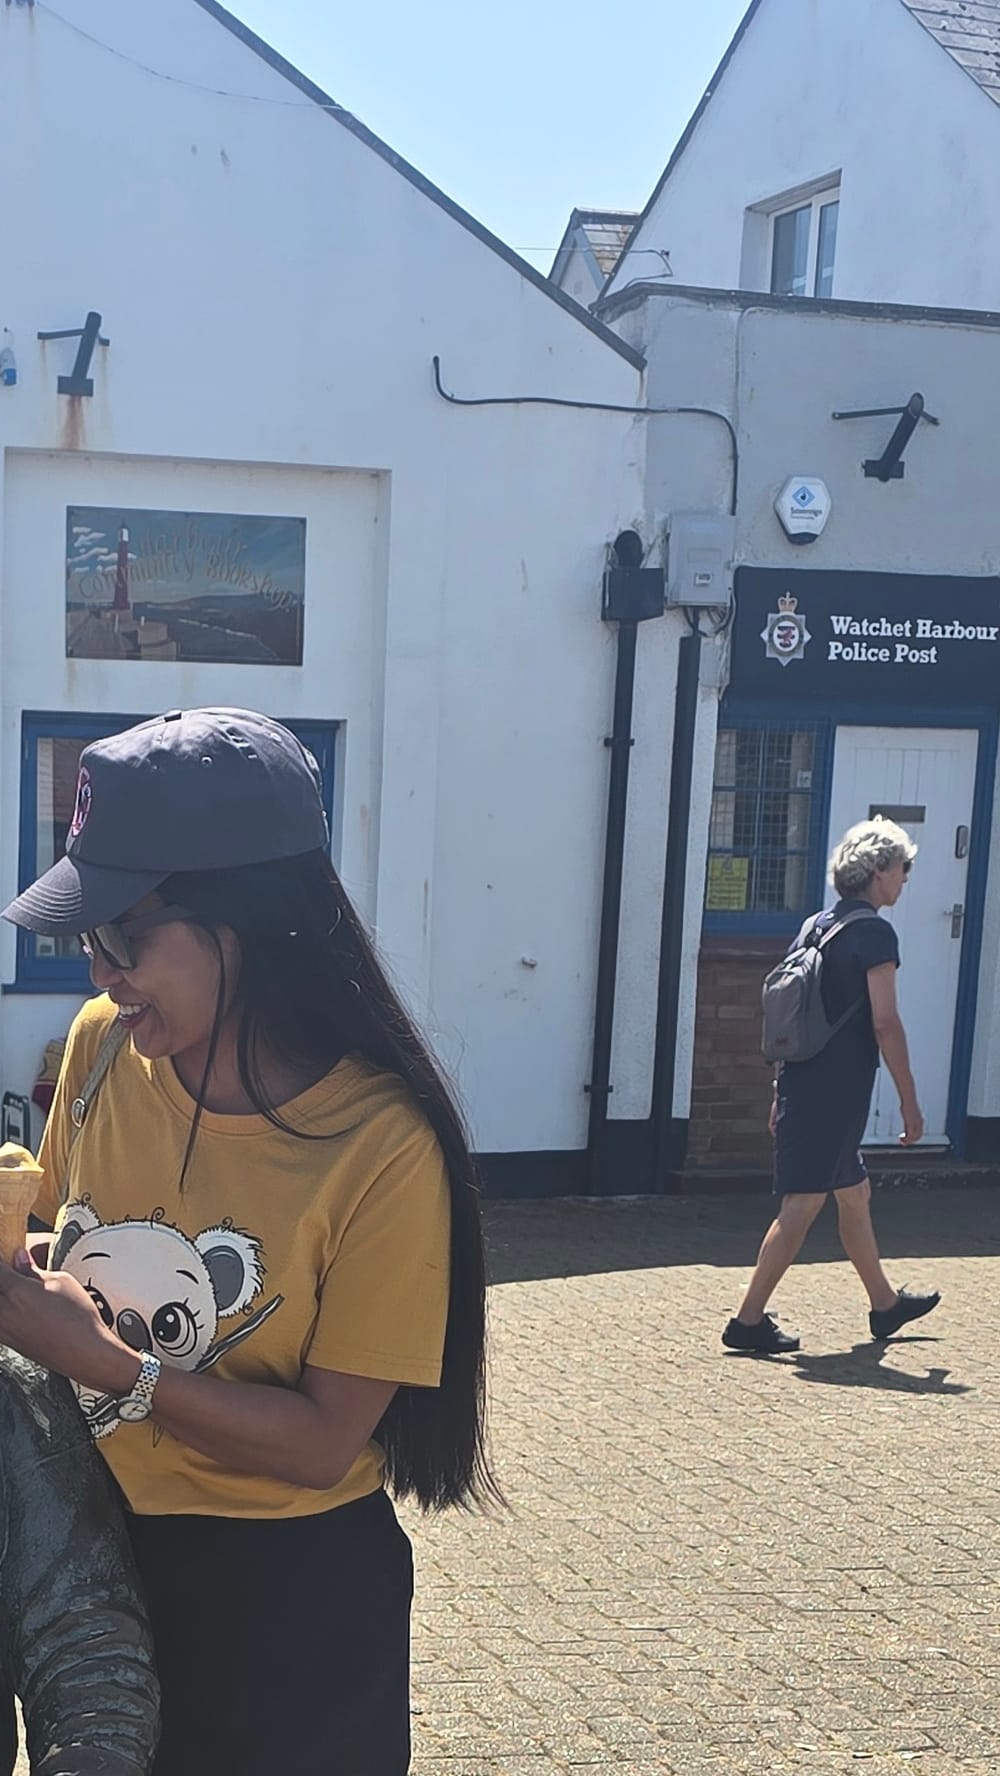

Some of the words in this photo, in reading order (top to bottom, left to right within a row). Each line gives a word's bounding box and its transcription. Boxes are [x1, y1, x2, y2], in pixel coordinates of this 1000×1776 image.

[830, 615, 912, 637] Watchet
[915, 619, 999, 641] Harbour
[828, 641, 890, 661] Police
[894, 643, 938, 664] Post
